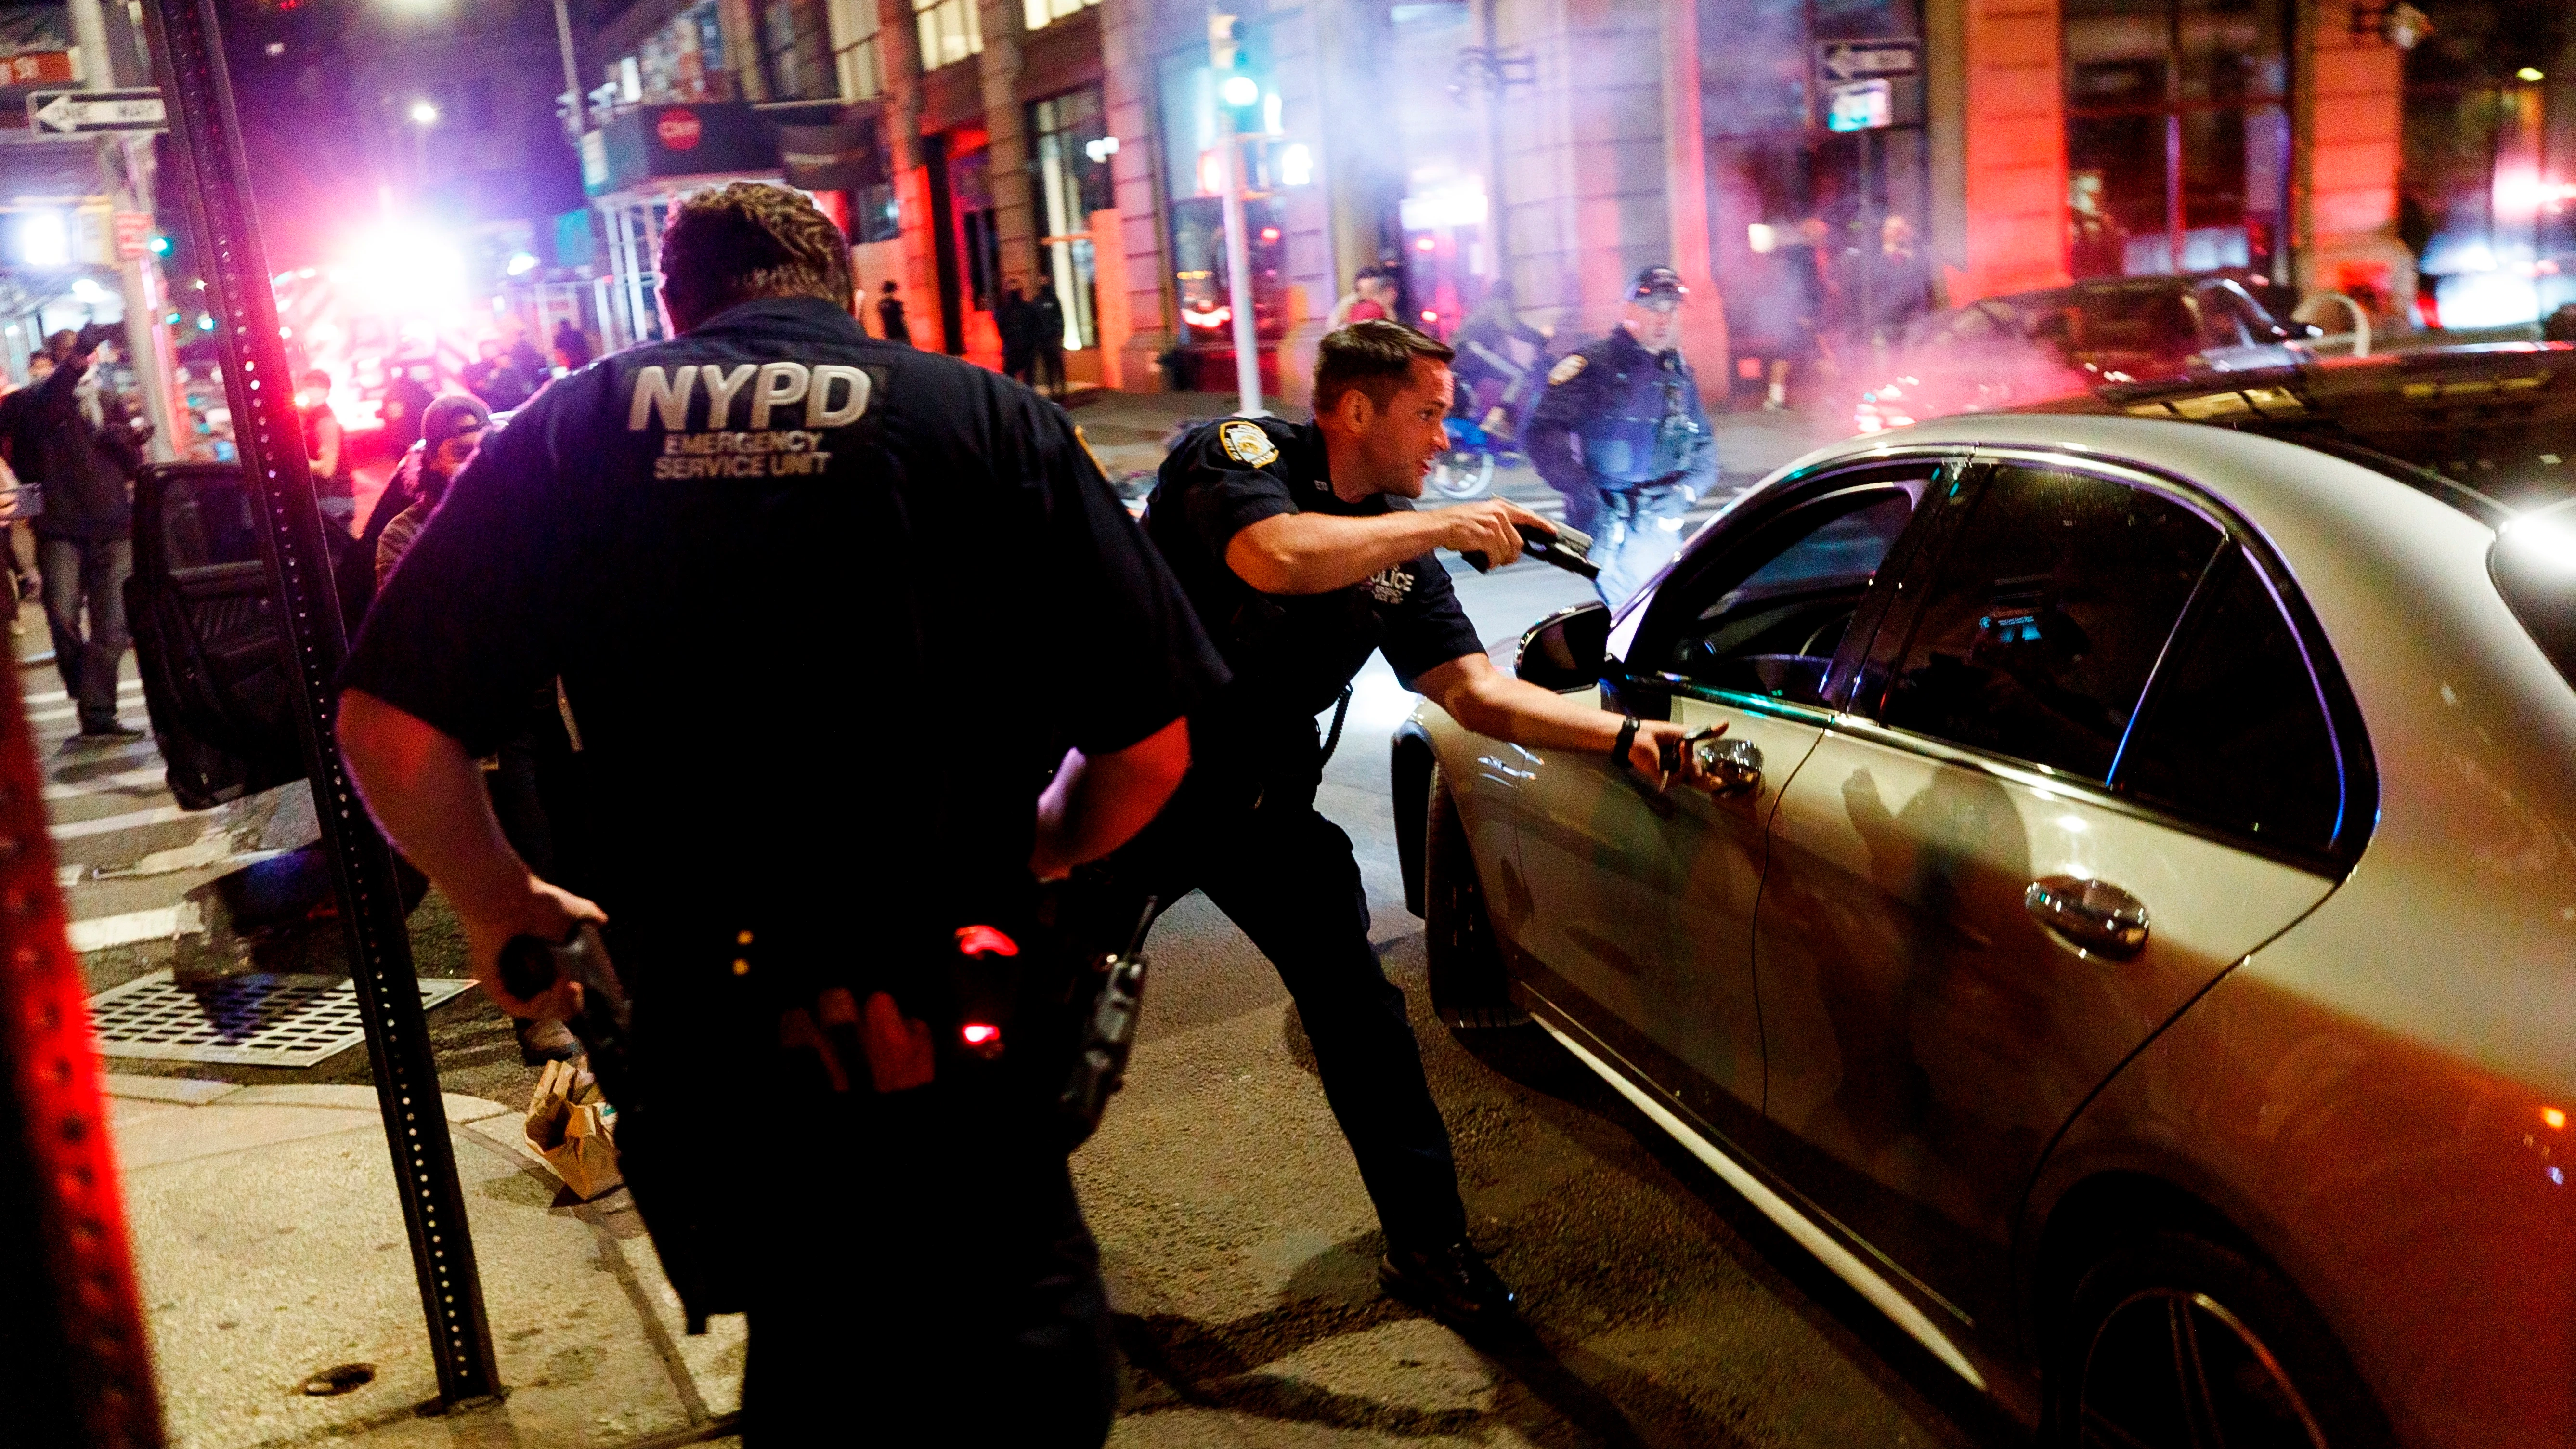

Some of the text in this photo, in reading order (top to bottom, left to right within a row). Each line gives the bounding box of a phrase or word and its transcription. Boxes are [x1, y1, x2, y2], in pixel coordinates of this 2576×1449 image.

[628, 362, 872, 431] NYPD
[664, 430, 824, 455] EMERGENCY
[655, 451, 832, 479] SERVICE UNIT
[1368, 569, 1415, 592] OLICE
